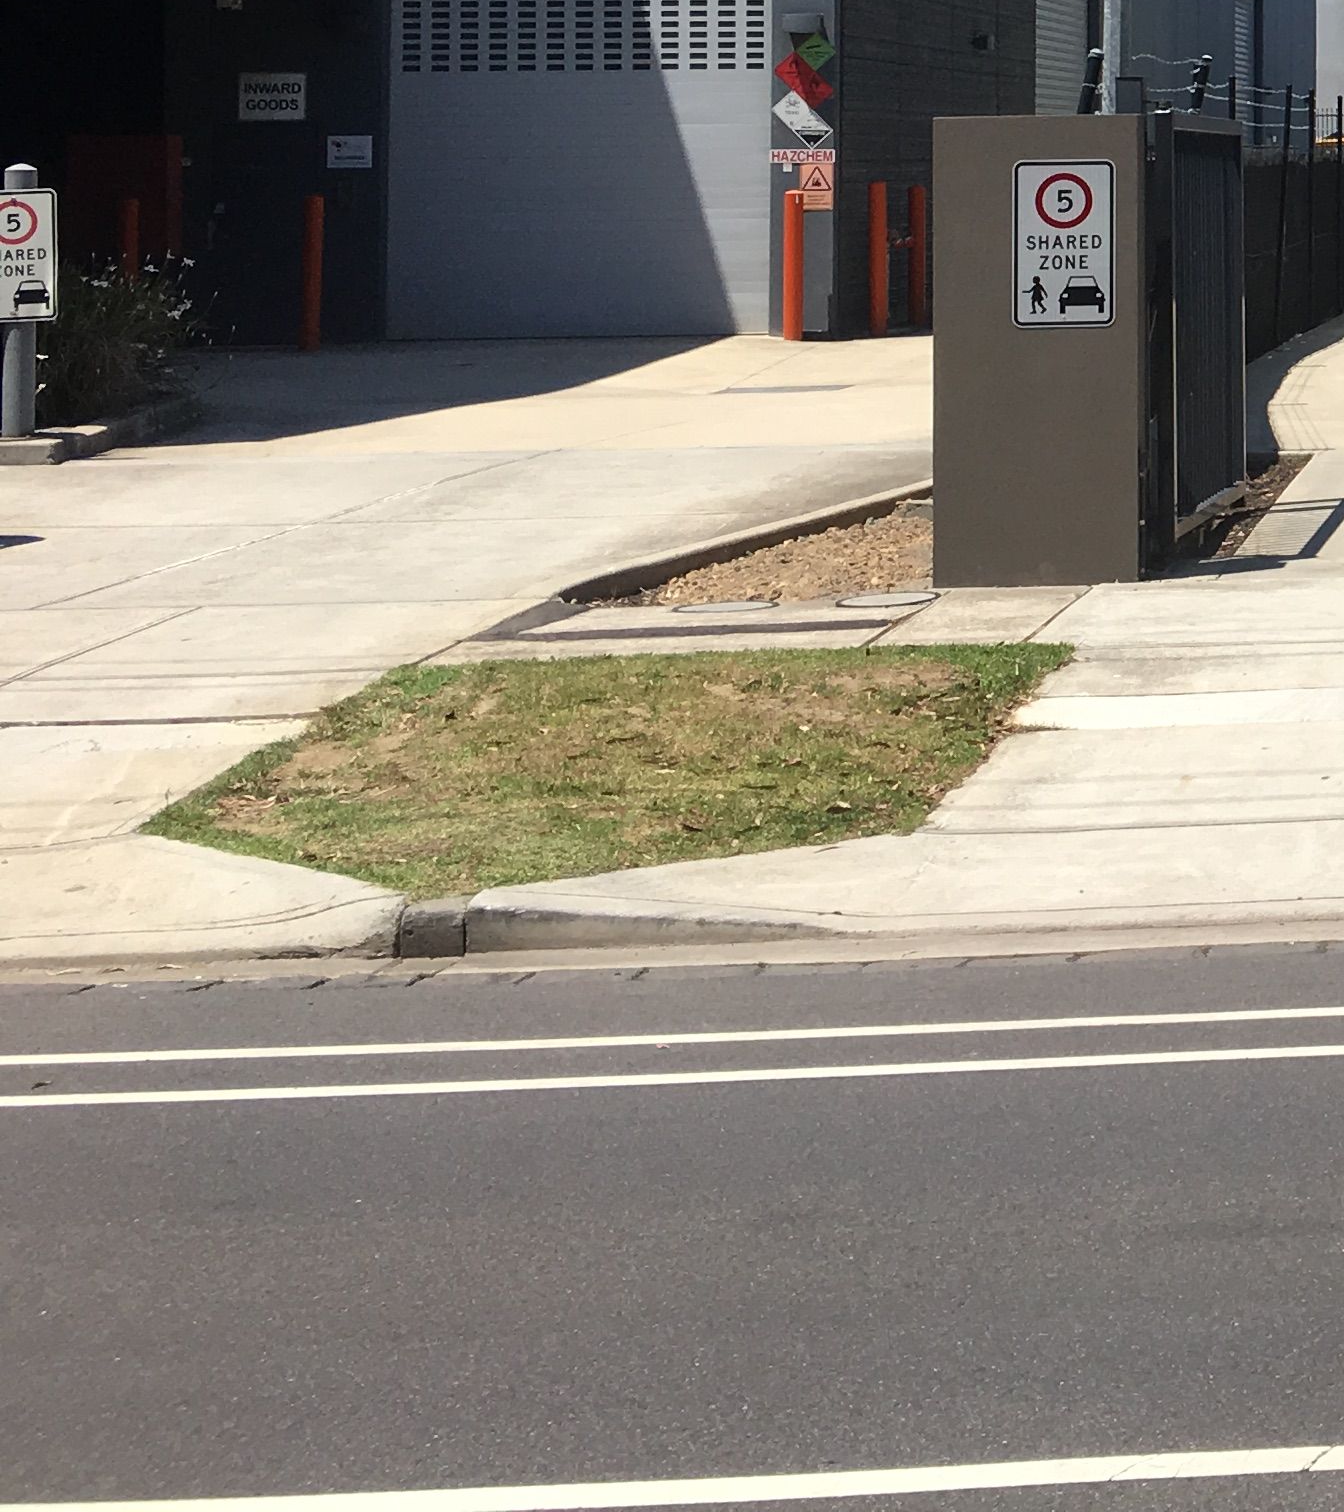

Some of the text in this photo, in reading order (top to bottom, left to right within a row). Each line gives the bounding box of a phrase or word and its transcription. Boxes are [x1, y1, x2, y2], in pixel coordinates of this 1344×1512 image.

[243, 82, 302, 95] INWARD
[245, 98, 299, 111] GOODS
[771, 150, 834, 163] HAZCHEM
[1057, 189, 1074, 214] 5
[6, 213, 21, 233] 5
[1026, 234, 1103, 251] SHARED
[0, 248, 47, 261] ARED
[1039, 254, 1089, 270] ZONE
[0, 264, 36, 277] ONE
